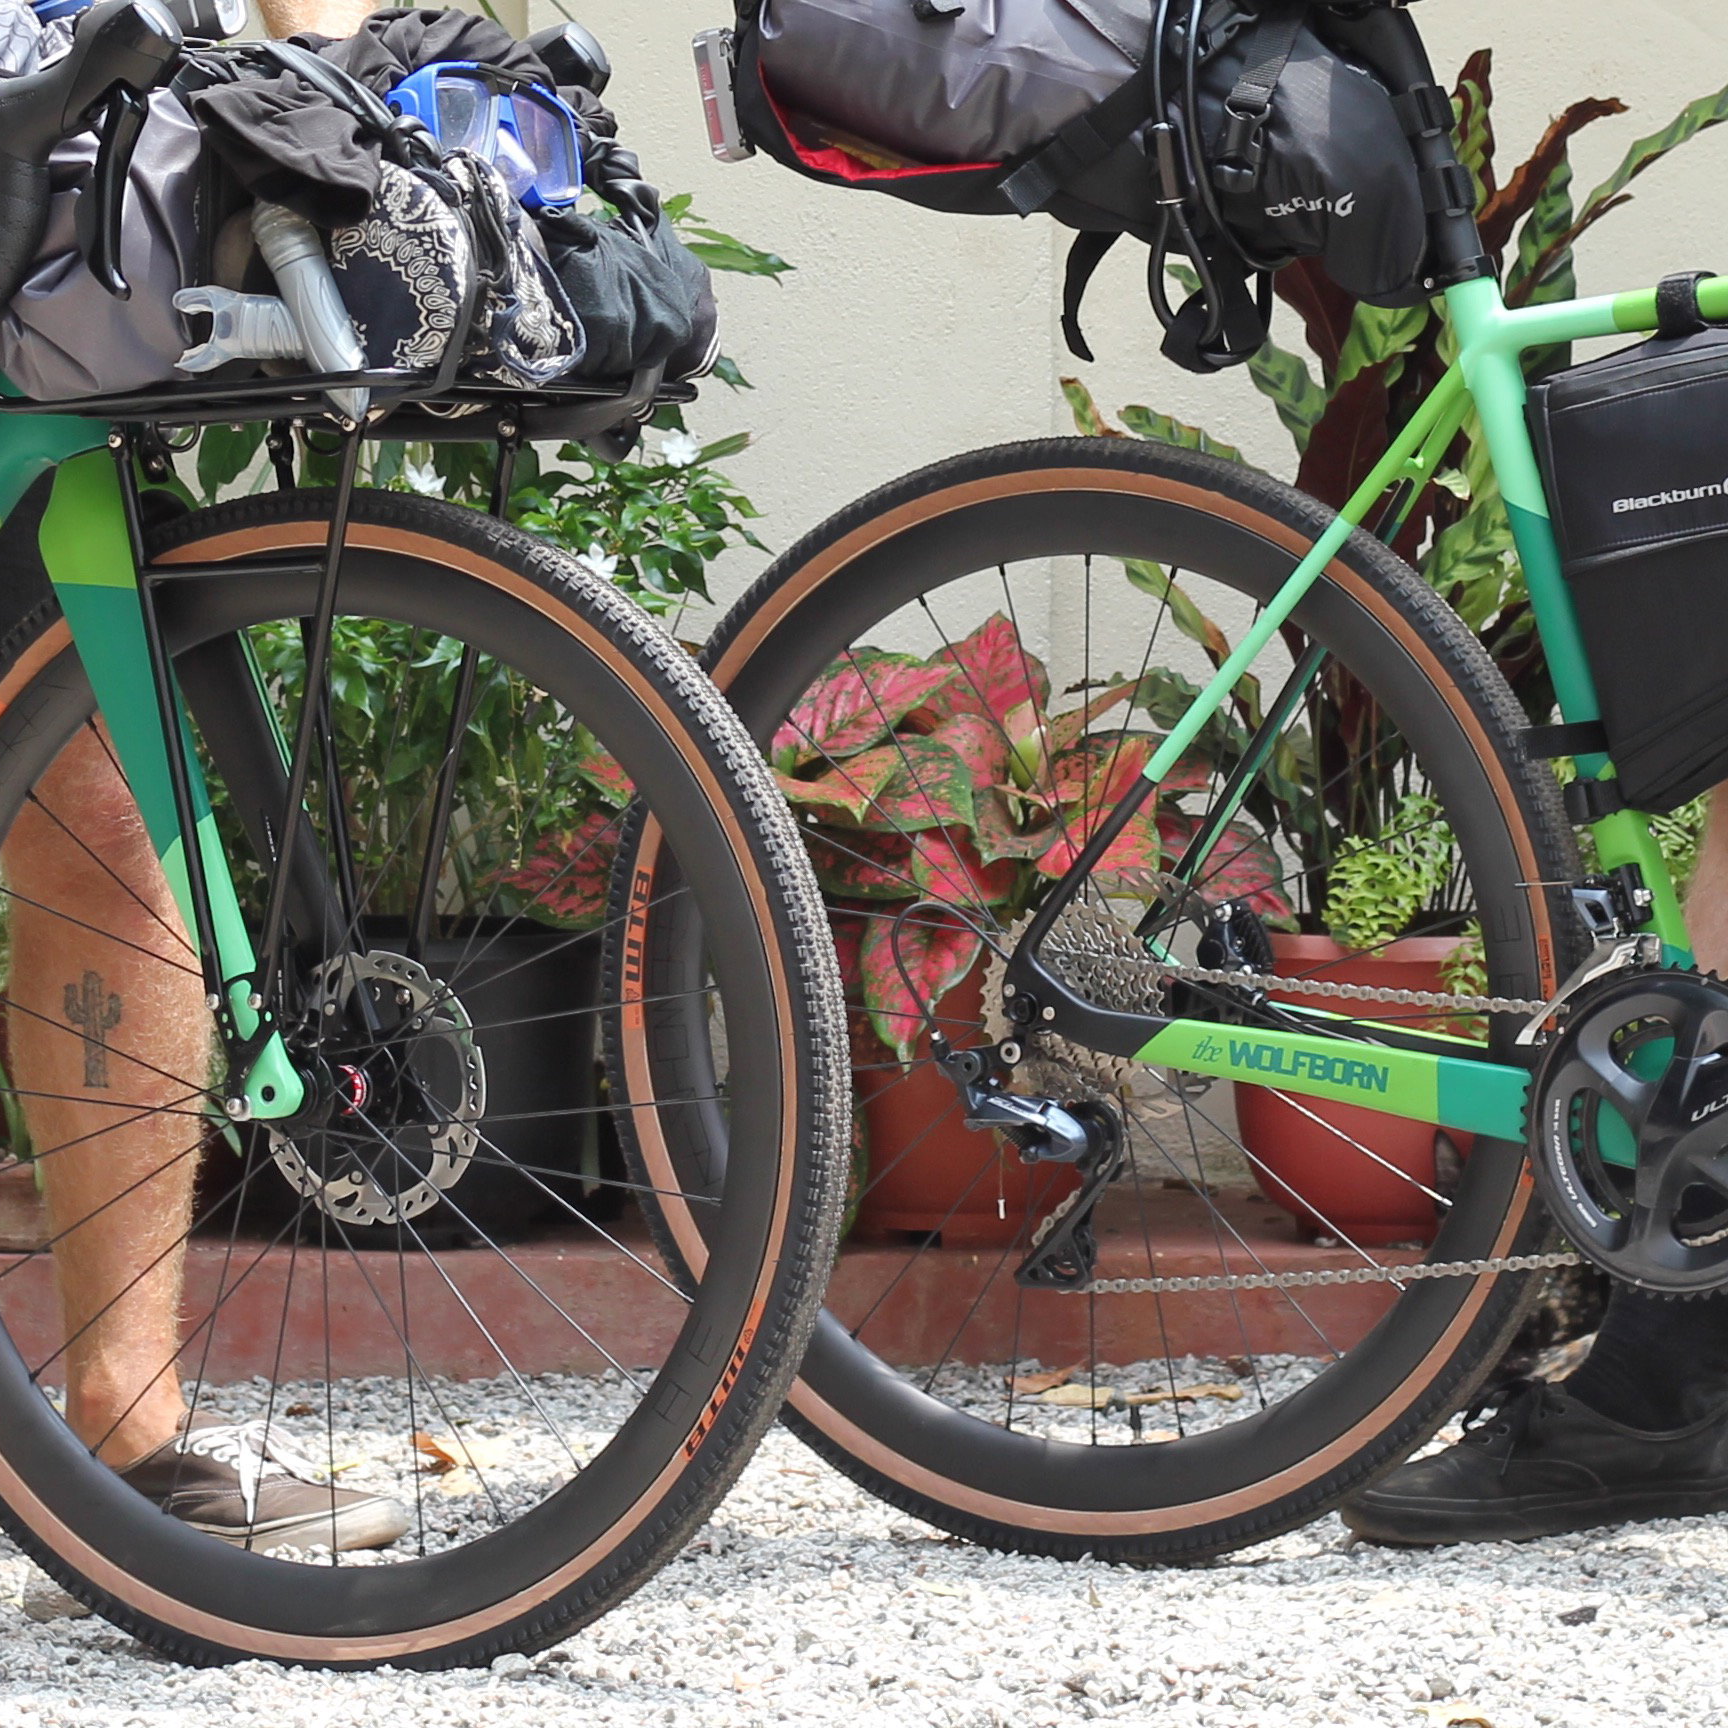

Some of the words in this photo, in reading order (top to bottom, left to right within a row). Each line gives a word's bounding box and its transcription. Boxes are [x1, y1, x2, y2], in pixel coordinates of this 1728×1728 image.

[1612, 483, 1722, 514] Blackburn
[1192, 1036, 1223, 1063] the
[1229, 1039, 1389, 1093] WOLFBORN
